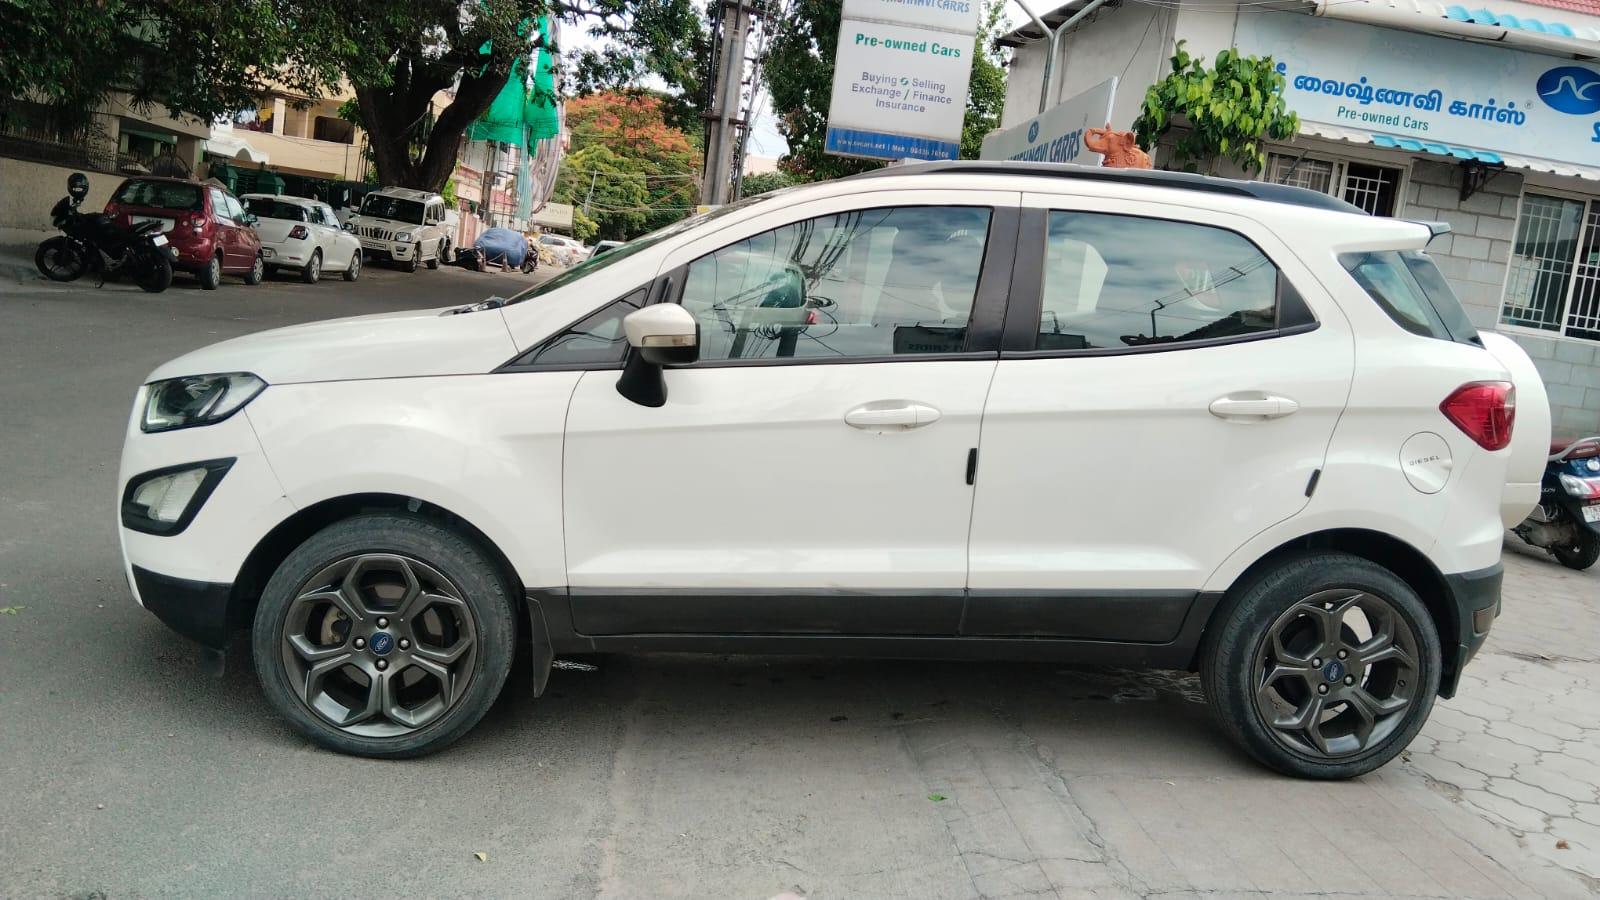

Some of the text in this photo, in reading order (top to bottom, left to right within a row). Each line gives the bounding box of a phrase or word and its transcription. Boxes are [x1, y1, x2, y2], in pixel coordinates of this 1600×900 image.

[855, 33, 961, 58] Pre-owned Cars
[861, 71, 946, 93] Buying Selling
[851, 83, 901, 99] Exchange
[912, 91, 952, 104] Finance
[1294, 75, 1443, 112] வைஷ்ணவி
[1448, 98, 1526, 126] கார்ஸ்
[875, 97, 926, 113] Insurance
[1337, 105, 1429, 131] Pre-owned Cars
[1409, 455, 1440, 466] DIESEL
